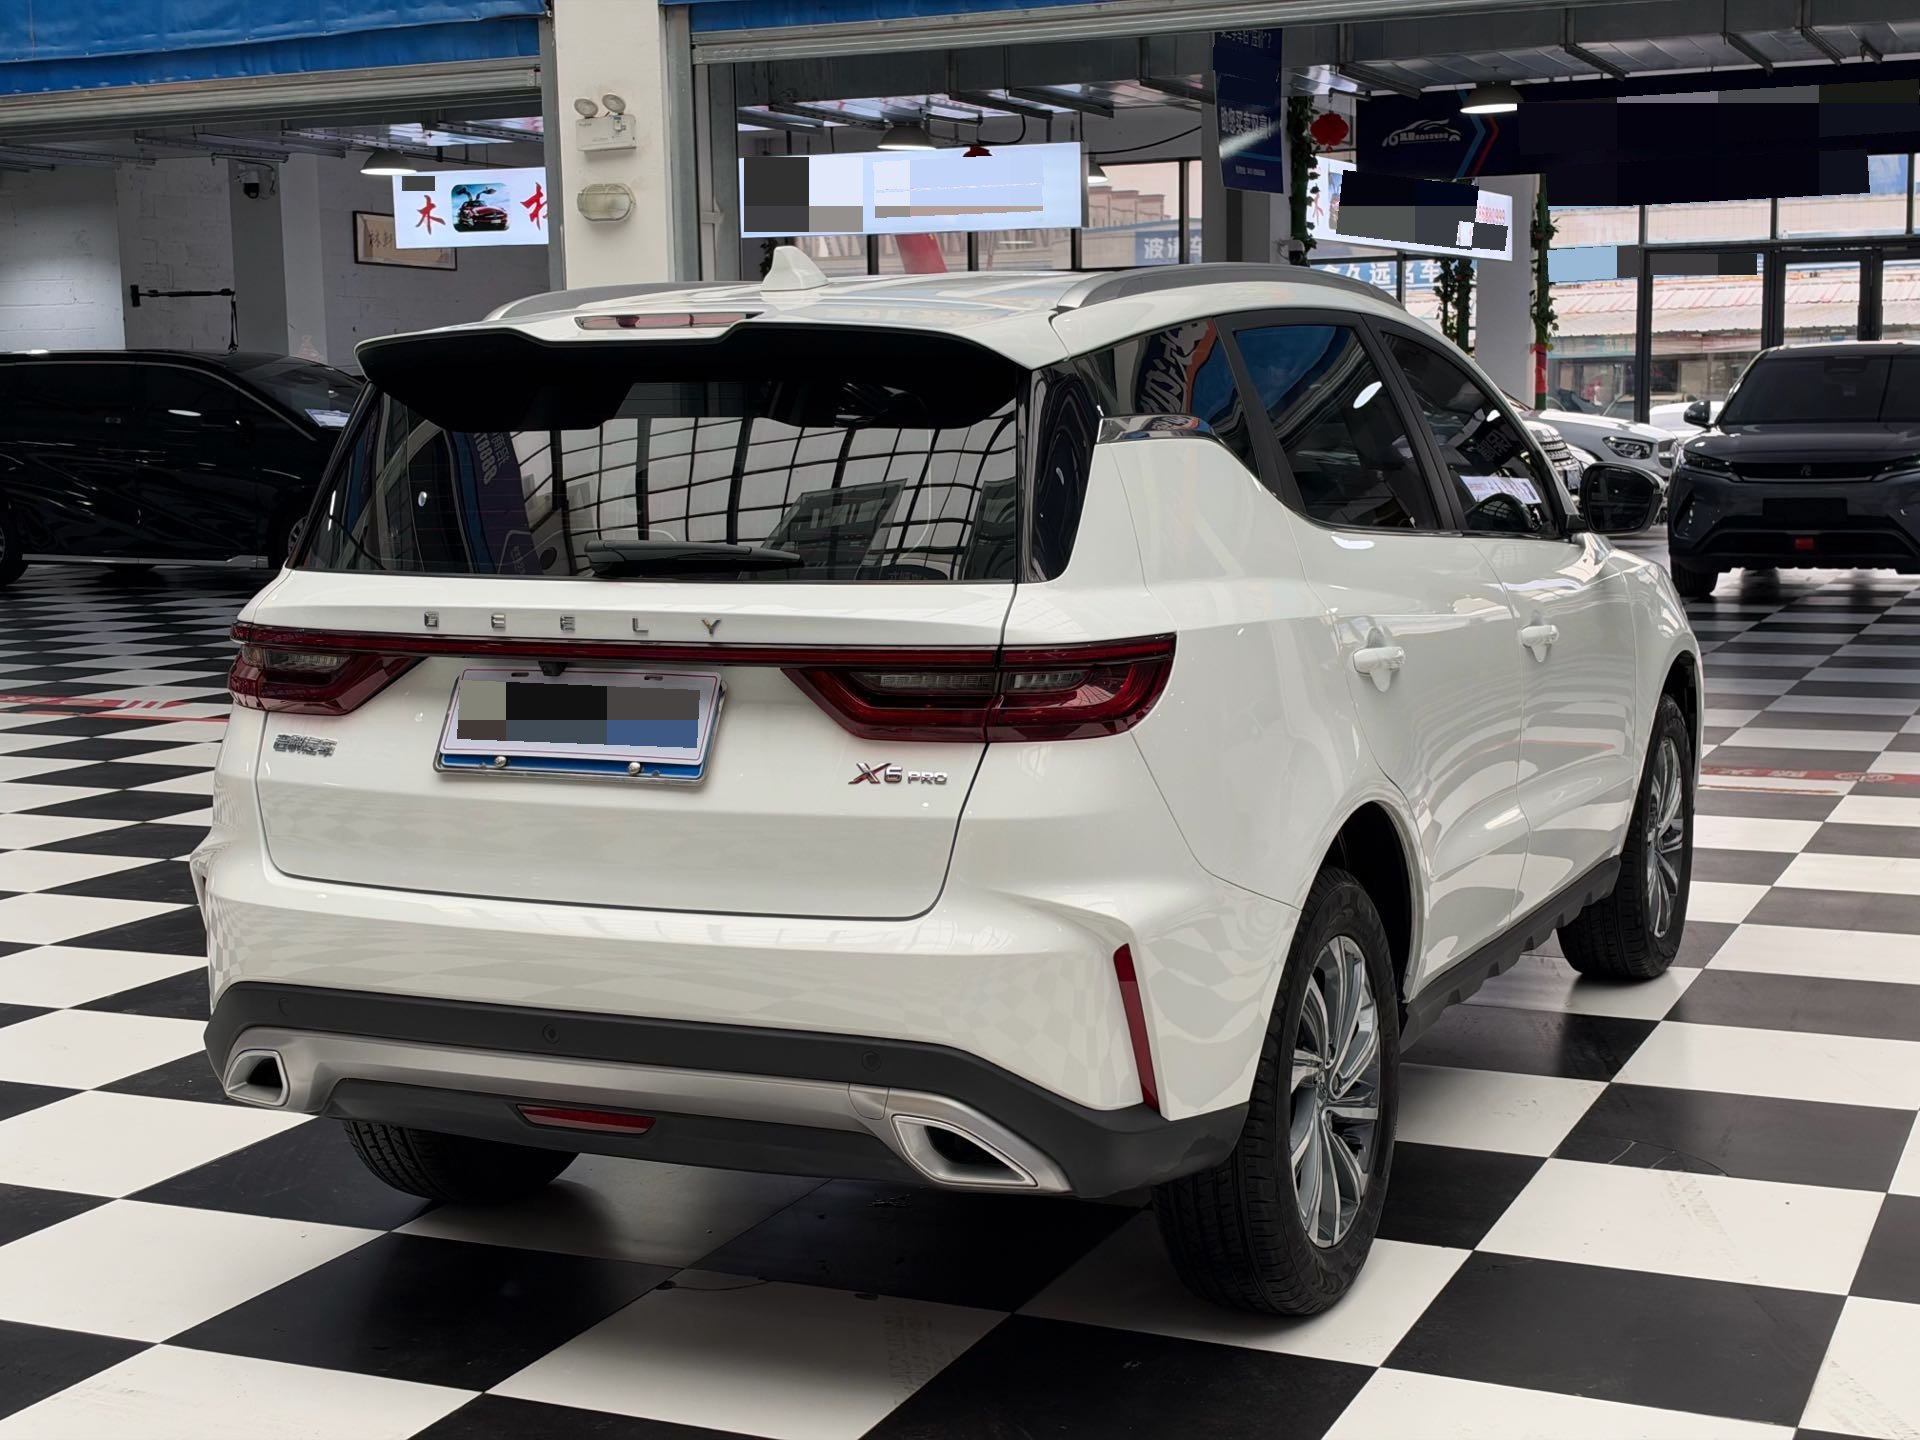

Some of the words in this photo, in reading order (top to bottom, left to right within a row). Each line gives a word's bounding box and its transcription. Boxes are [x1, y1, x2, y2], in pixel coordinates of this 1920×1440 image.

[415, 194, 446, 236] 木
[424, 611, 722, 635] GEELY
[848, 762, 903, 785] X6
[907, 770, 948, 785] PRO
